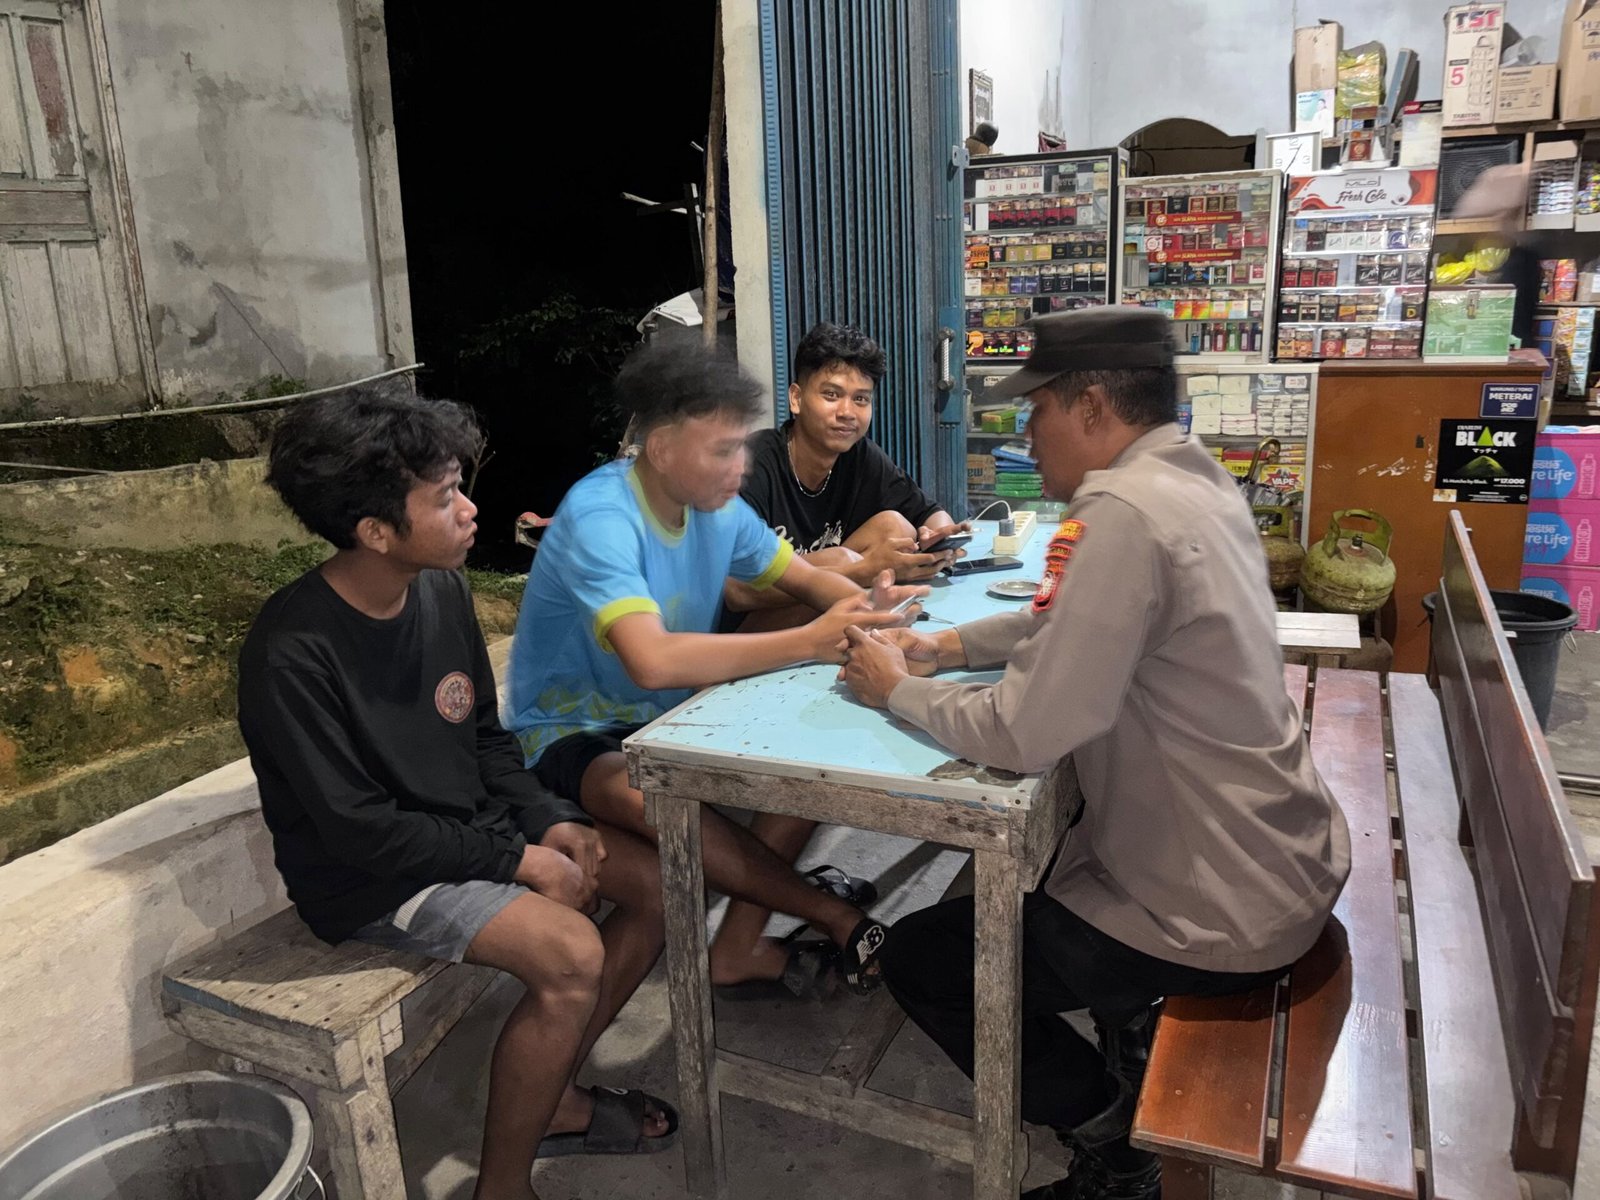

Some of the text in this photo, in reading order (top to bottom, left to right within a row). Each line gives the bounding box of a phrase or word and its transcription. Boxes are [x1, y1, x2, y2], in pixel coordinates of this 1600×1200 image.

[1455, 9, 1501, 29] TST
[1450, 66, 1464, 86] 5
[1335, 189, 1387, 204] Fresh Cola
[1489, 393, 1533, 401] METERAI
[1455, 426, 1517, 447] BLACK
[1548, 469, 1573, 485] Life
[1543, 533, 1568, 549] Life
